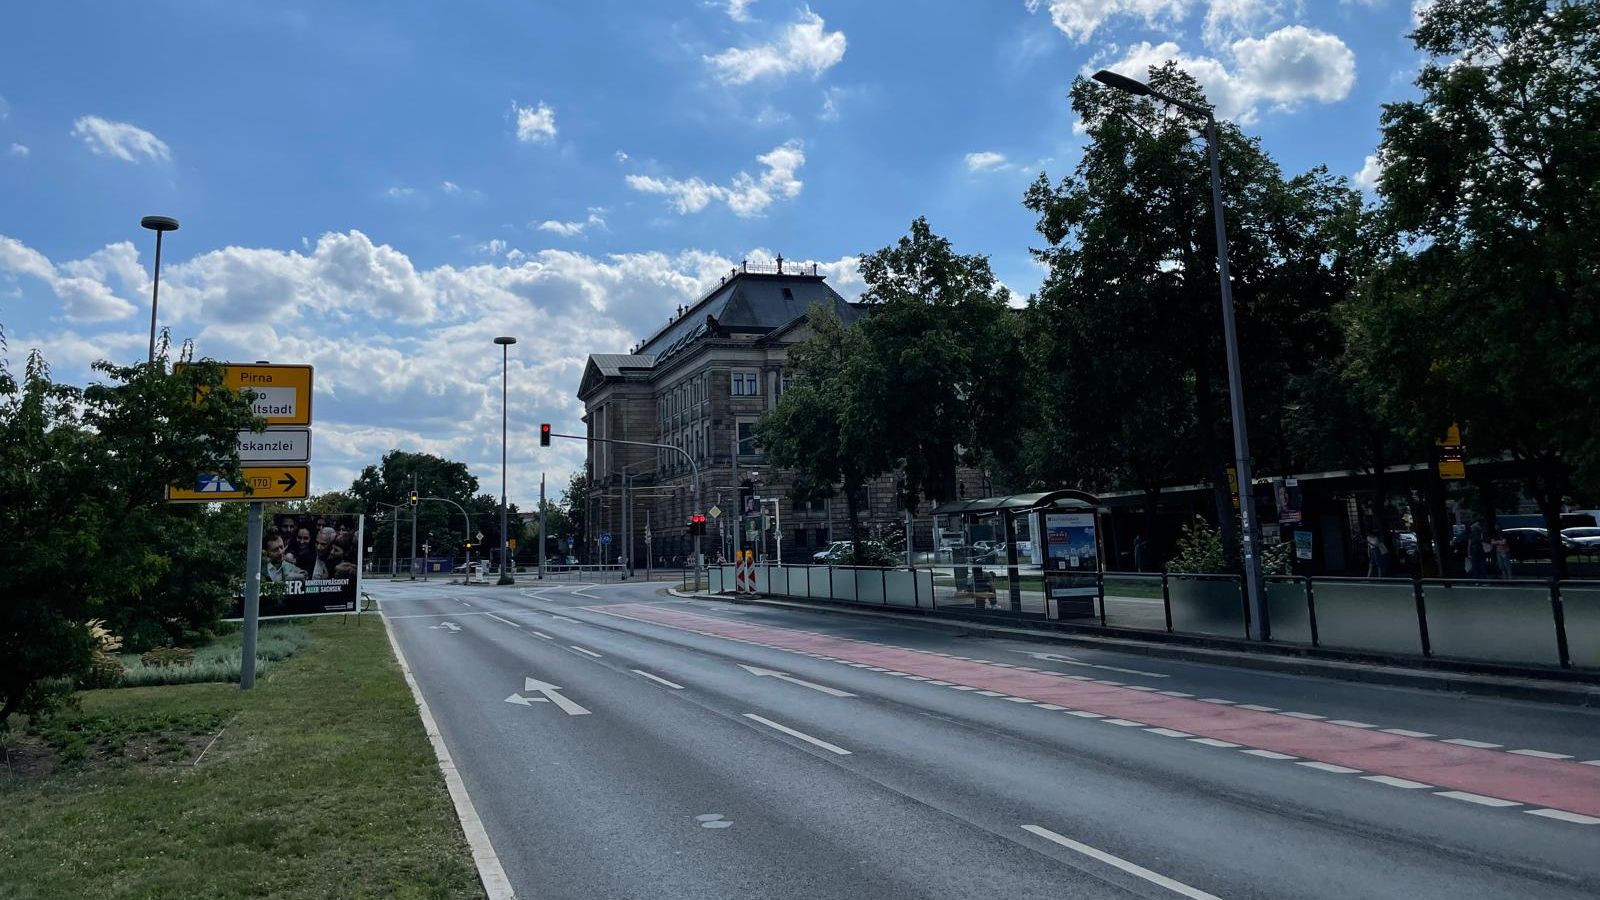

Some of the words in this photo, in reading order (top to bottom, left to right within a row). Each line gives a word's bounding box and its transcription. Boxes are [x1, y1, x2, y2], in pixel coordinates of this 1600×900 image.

[240, 372, 272, 382] Pirna
[253, 404, 292, 414] ltstadt
[238, 440, 293, 451] tskanzlei
[254, 478, 268, 487] 170
